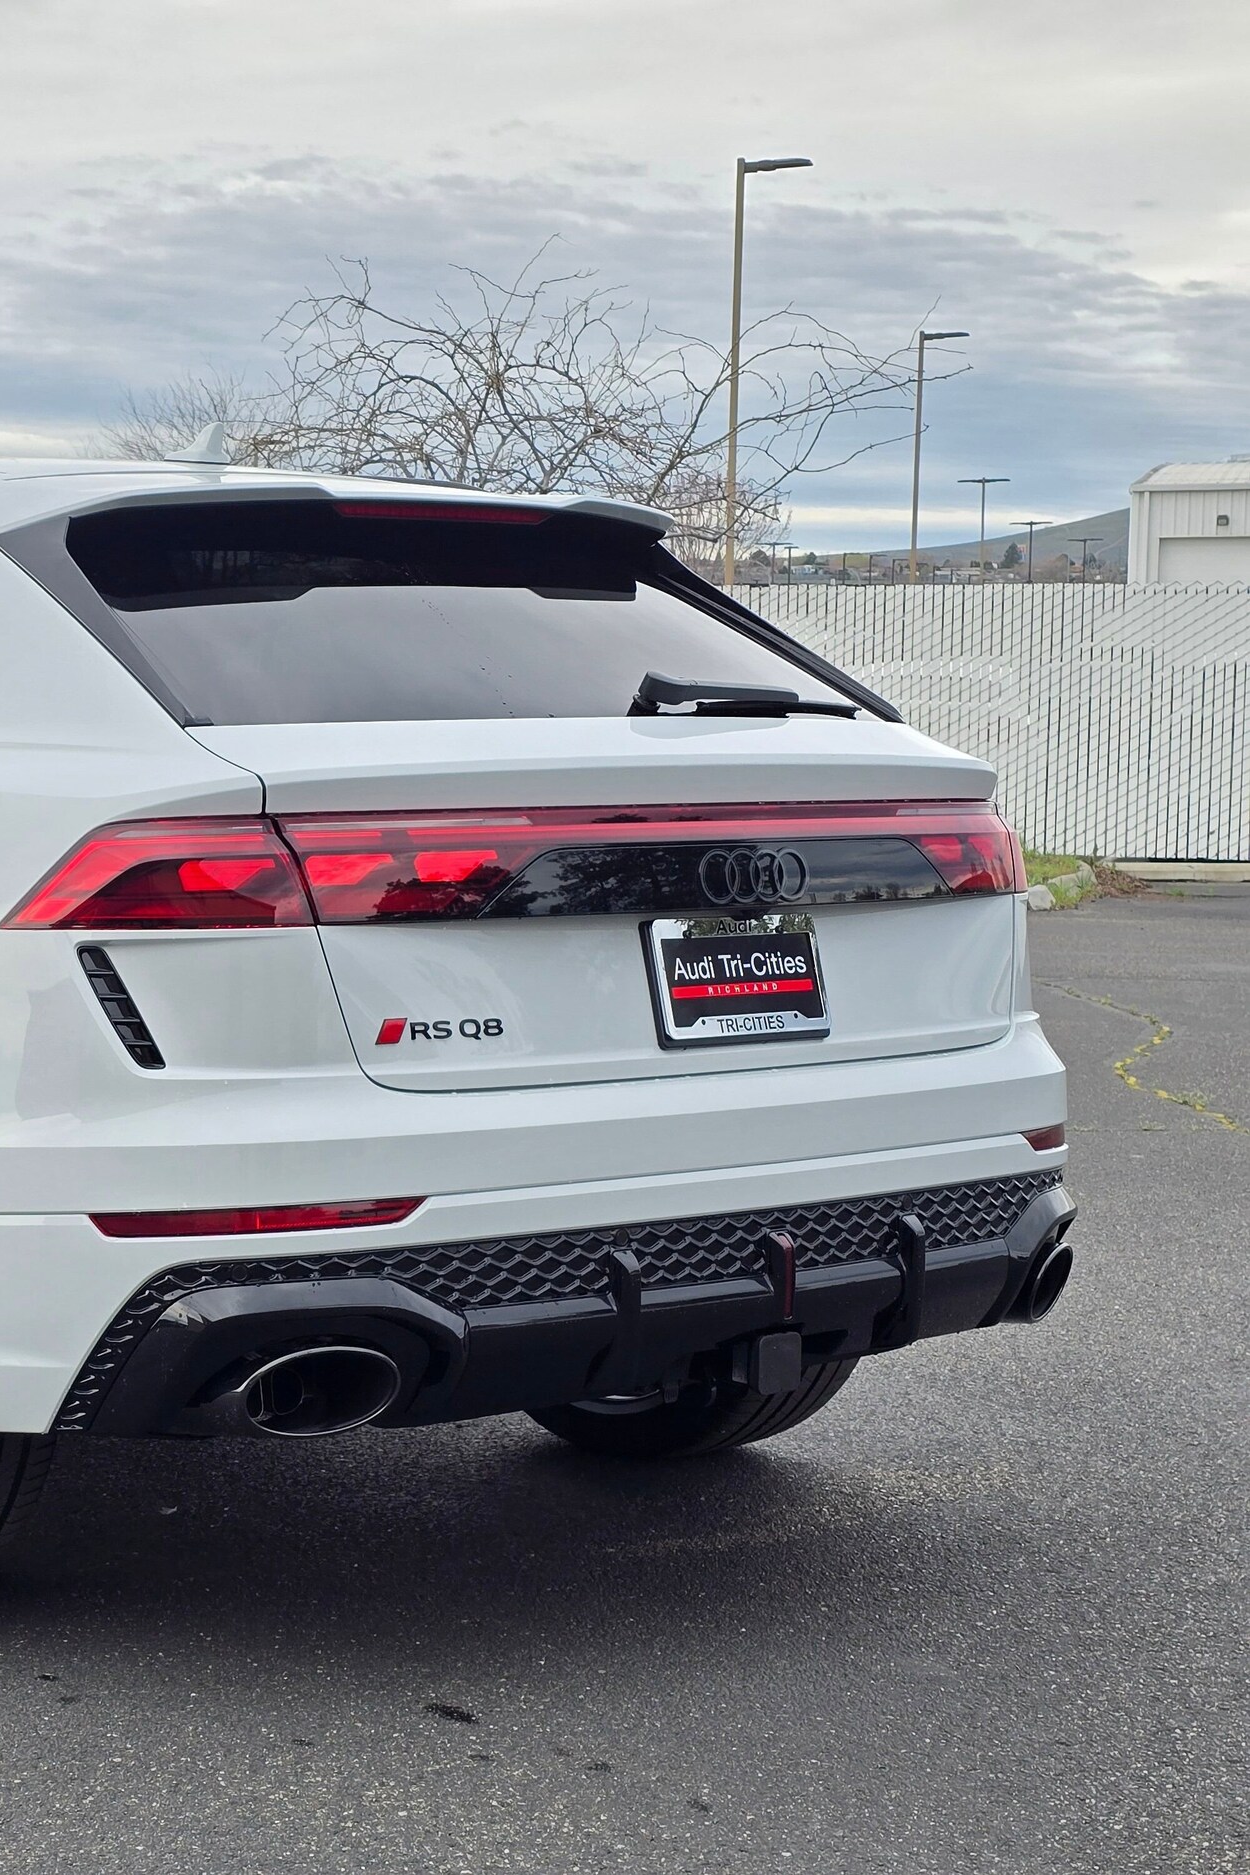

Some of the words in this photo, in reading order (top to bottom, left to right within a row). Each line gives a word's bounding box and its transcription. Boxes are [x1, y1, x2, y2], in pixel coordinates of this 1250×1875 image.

[674, 956, 716, 981] Audi
[718, 951, 807, 978] Tri-Cities
[707, 982, 778, 995] RICHLAND
[410, 1021, 453, 1040] RS
[459, 1018, 504, 1040] Q8
[717, 1015, 785, 1033] TRI-CITIES
